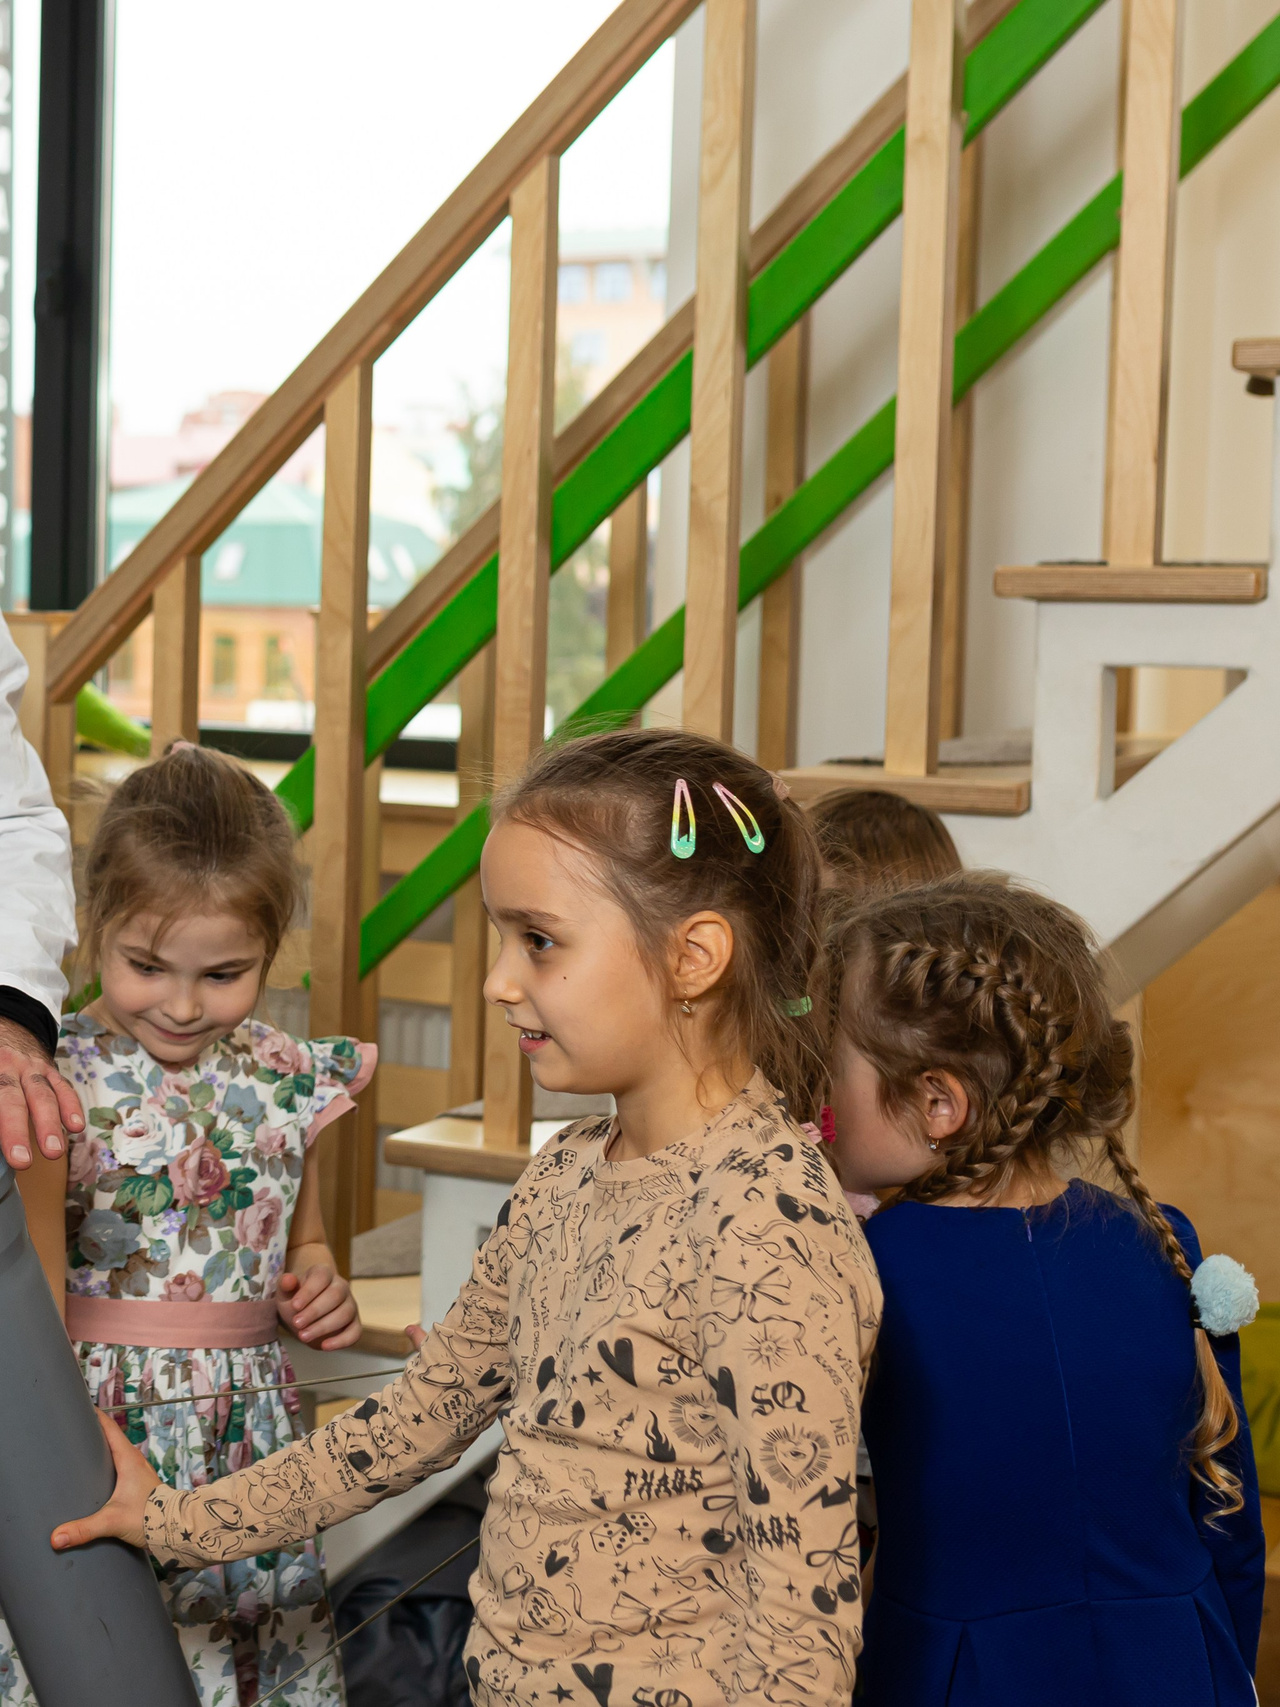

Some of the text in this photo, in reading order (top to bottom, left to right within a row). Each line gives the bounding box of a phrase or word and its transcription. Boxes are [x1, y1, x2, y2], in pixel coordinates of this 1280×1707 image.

[545, 1436, 579, 1450] FEARS
[830, 1416, 851, 1447] ME
[324, 1436, 338, 1464] YOUR
